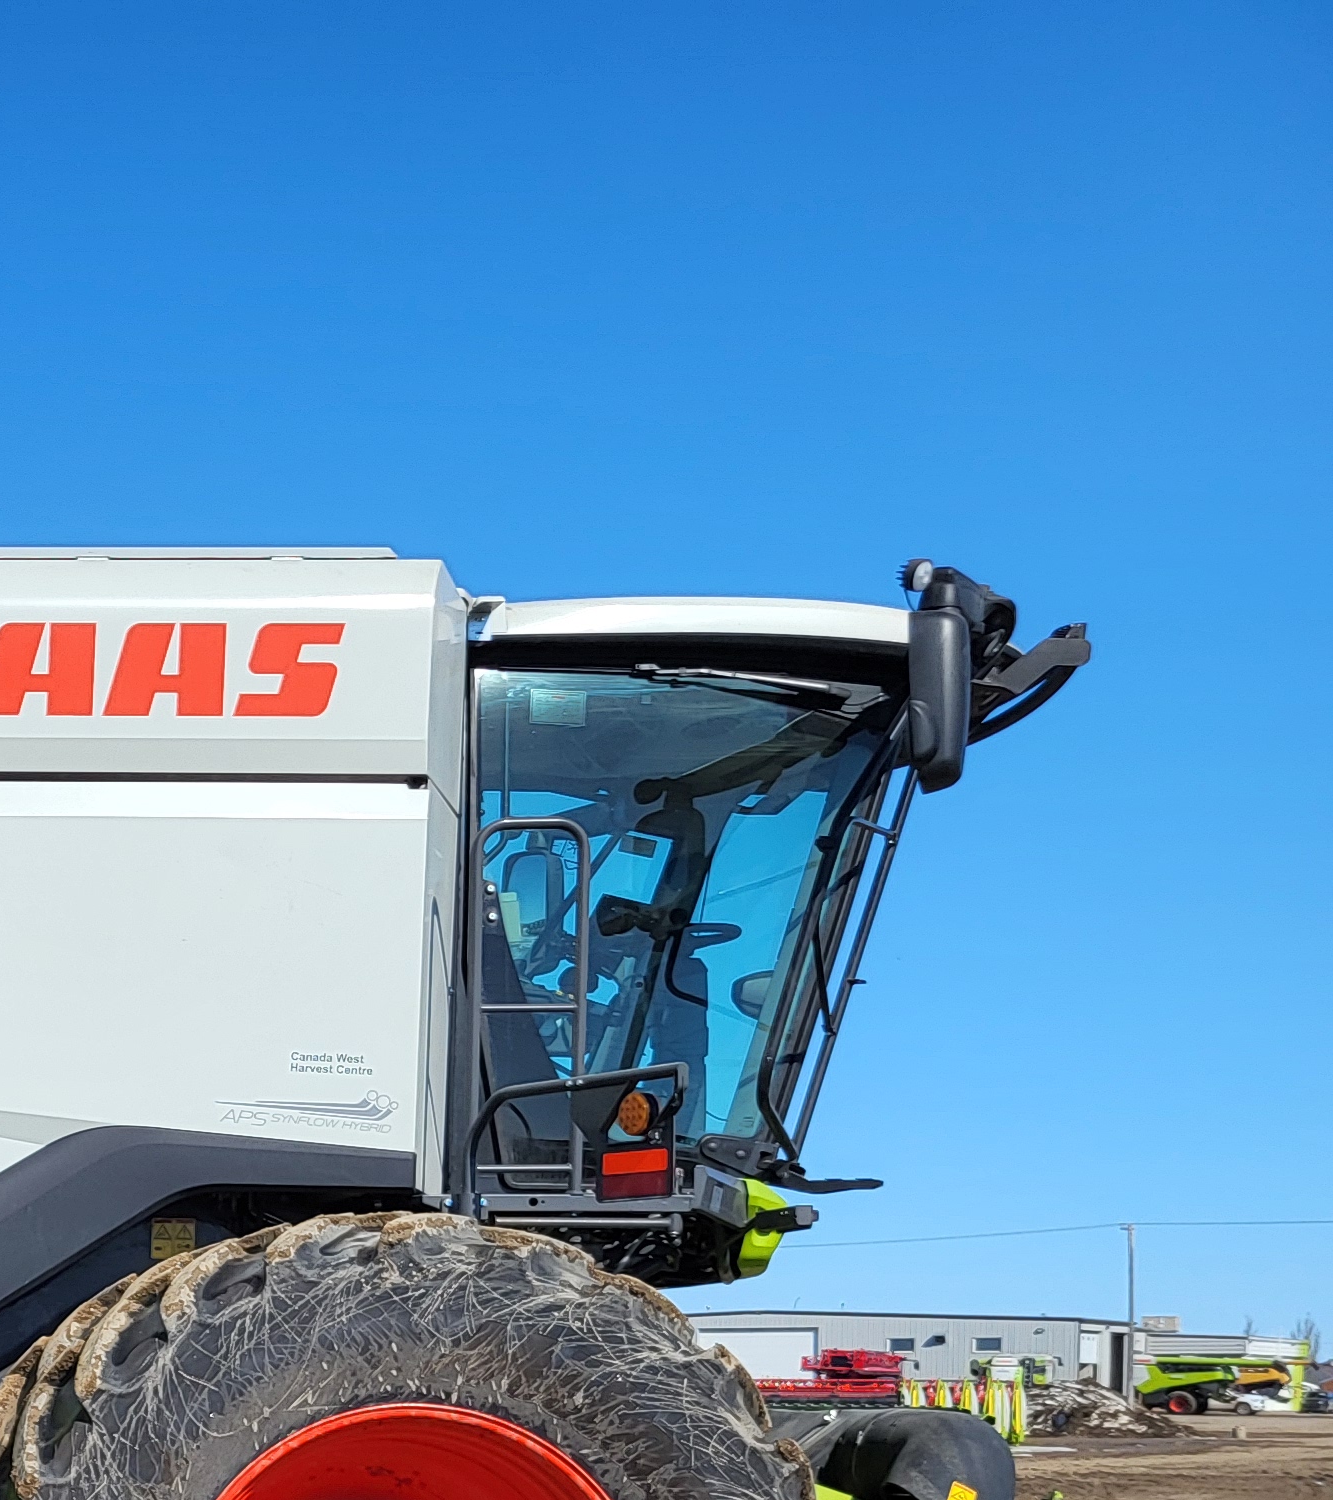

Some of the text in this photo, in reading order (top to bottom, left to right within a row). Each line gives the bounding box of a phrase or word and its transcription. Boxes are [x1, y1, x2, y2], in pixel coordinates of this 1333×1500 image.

[290, 1051, 365, 1064] Canada West
[289, 1062, 374, 1076] Harvest Centre
[219, 1108, 392, 1134] APS SYNFLOW HYBRID
